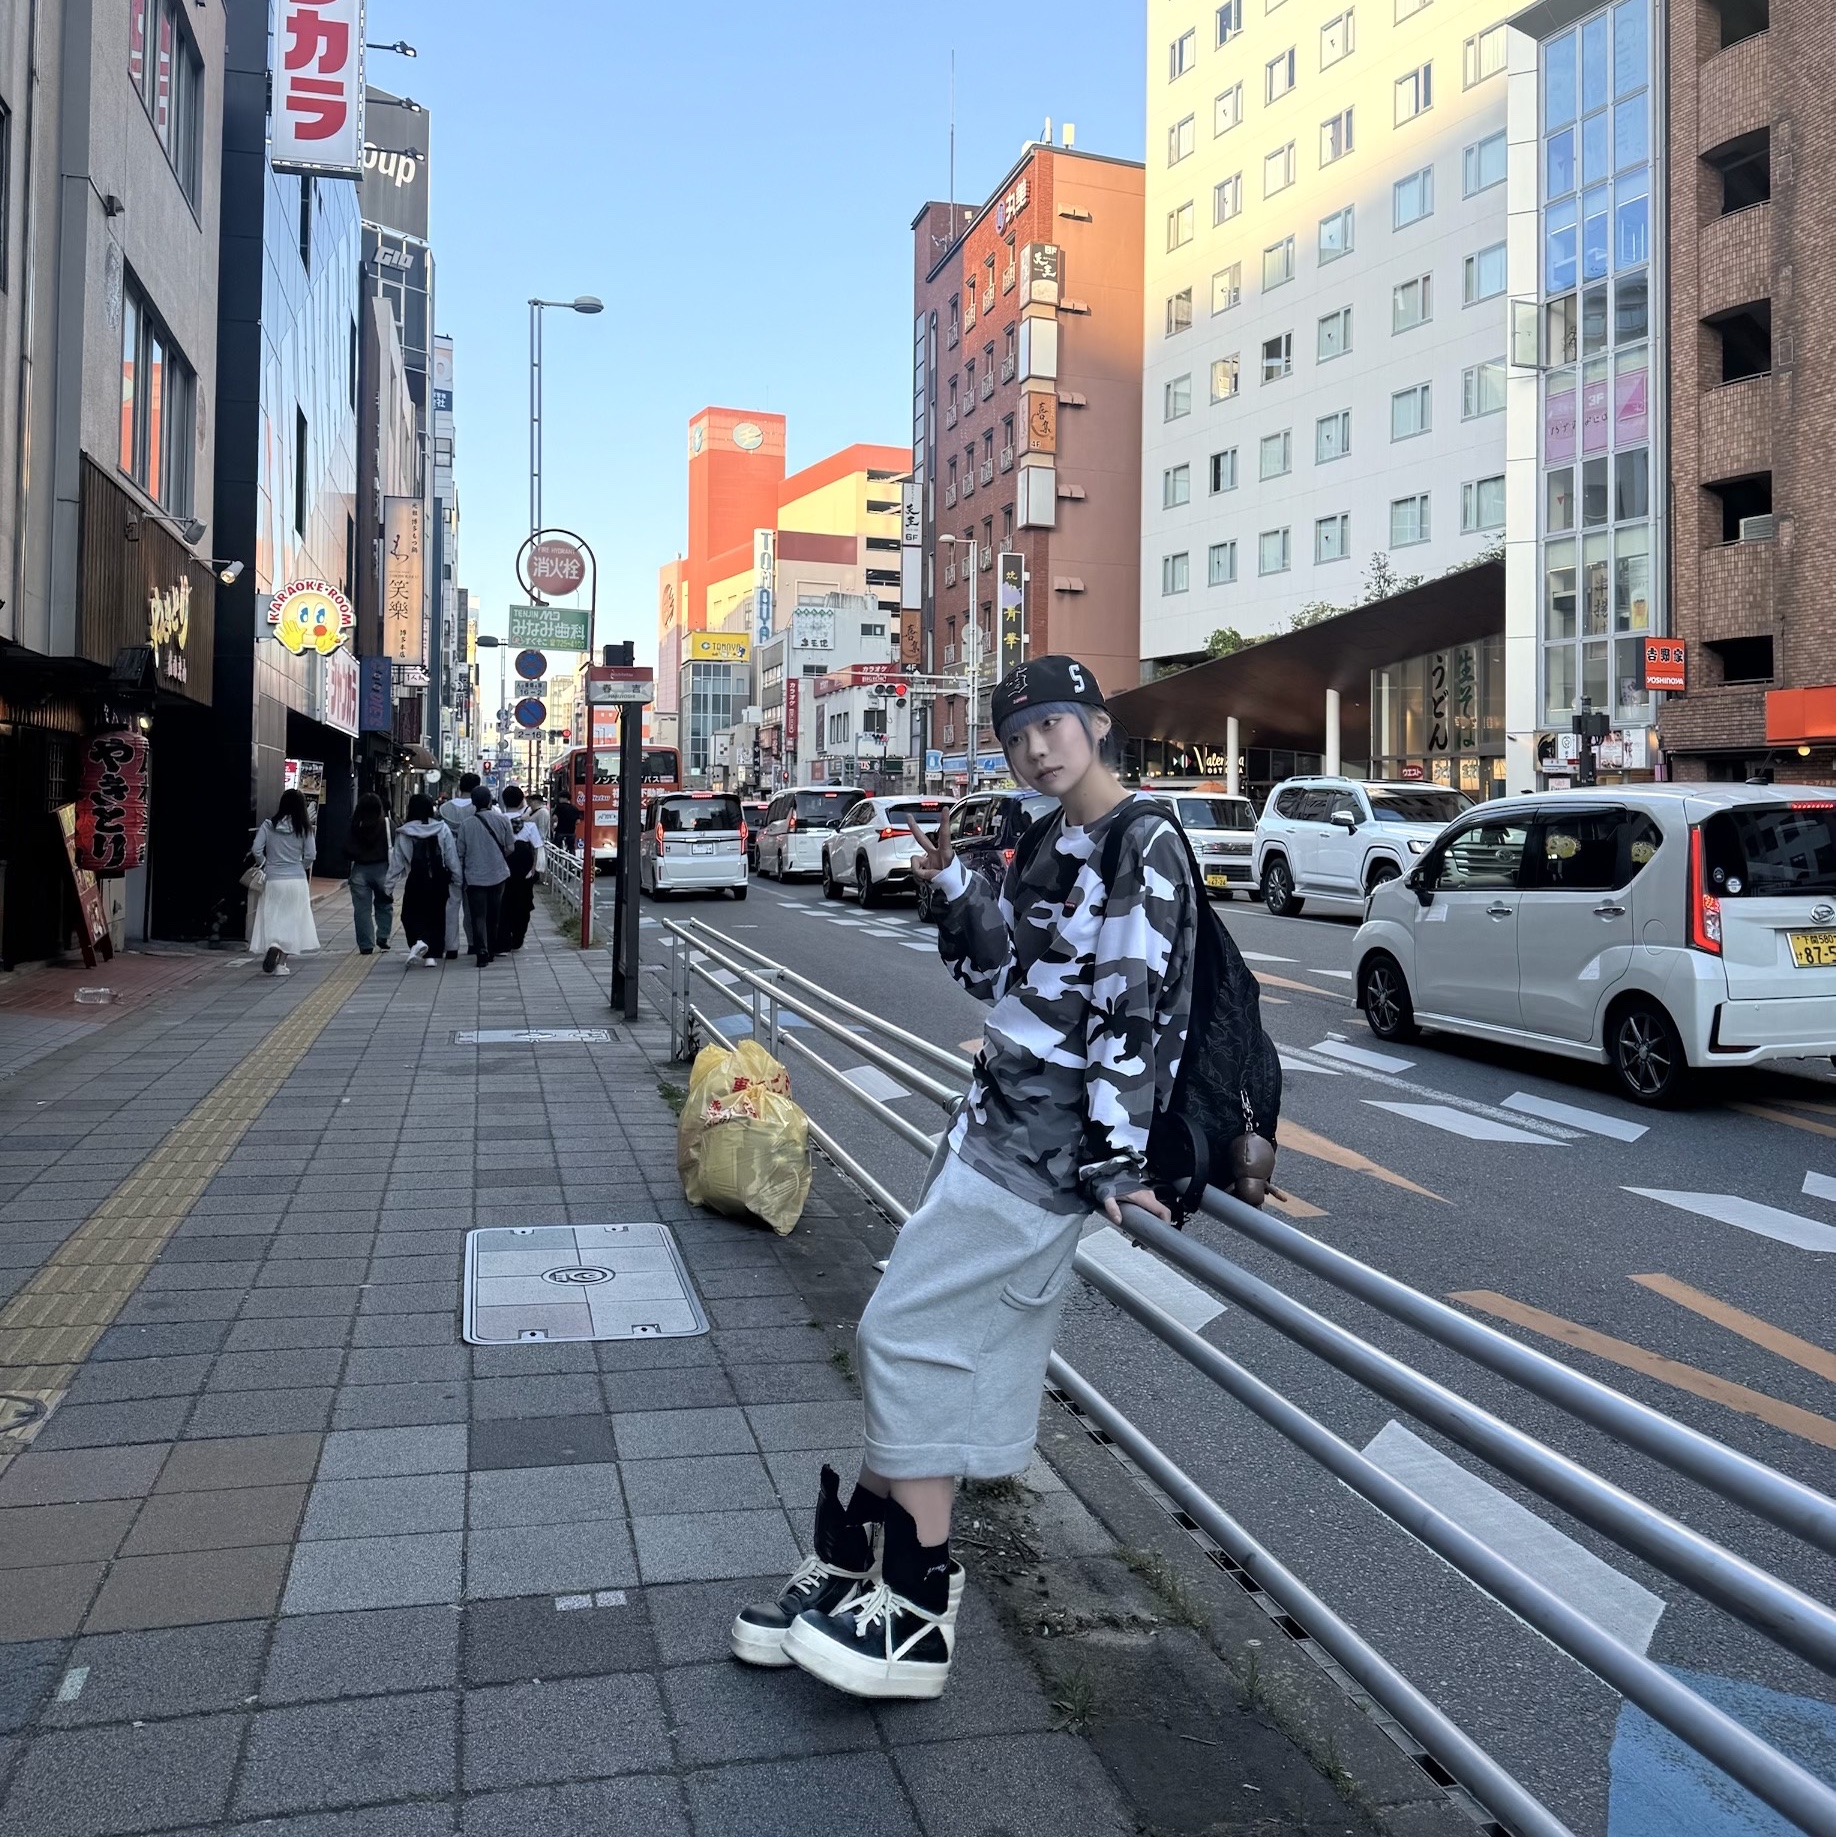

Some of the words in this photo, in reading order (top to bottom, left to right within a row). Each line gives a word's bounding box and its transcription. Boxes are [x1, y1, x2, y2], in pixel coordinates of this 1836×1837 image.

[905, 533, 918, 541] 6F
[533, 556, 580, 579] 消火栓
[514, 609, 539, 618] TENJIN
[512, 619, 586, 640] みなみ歯科
[1647, 648, 1684, 662] 吉野家
[862, 666, 888, 674] カラオケ
[1069, 664, 1085, 693] S
[1429, 654, 1449, 752] うどん
[88, 737, 136, 870] やきとり
